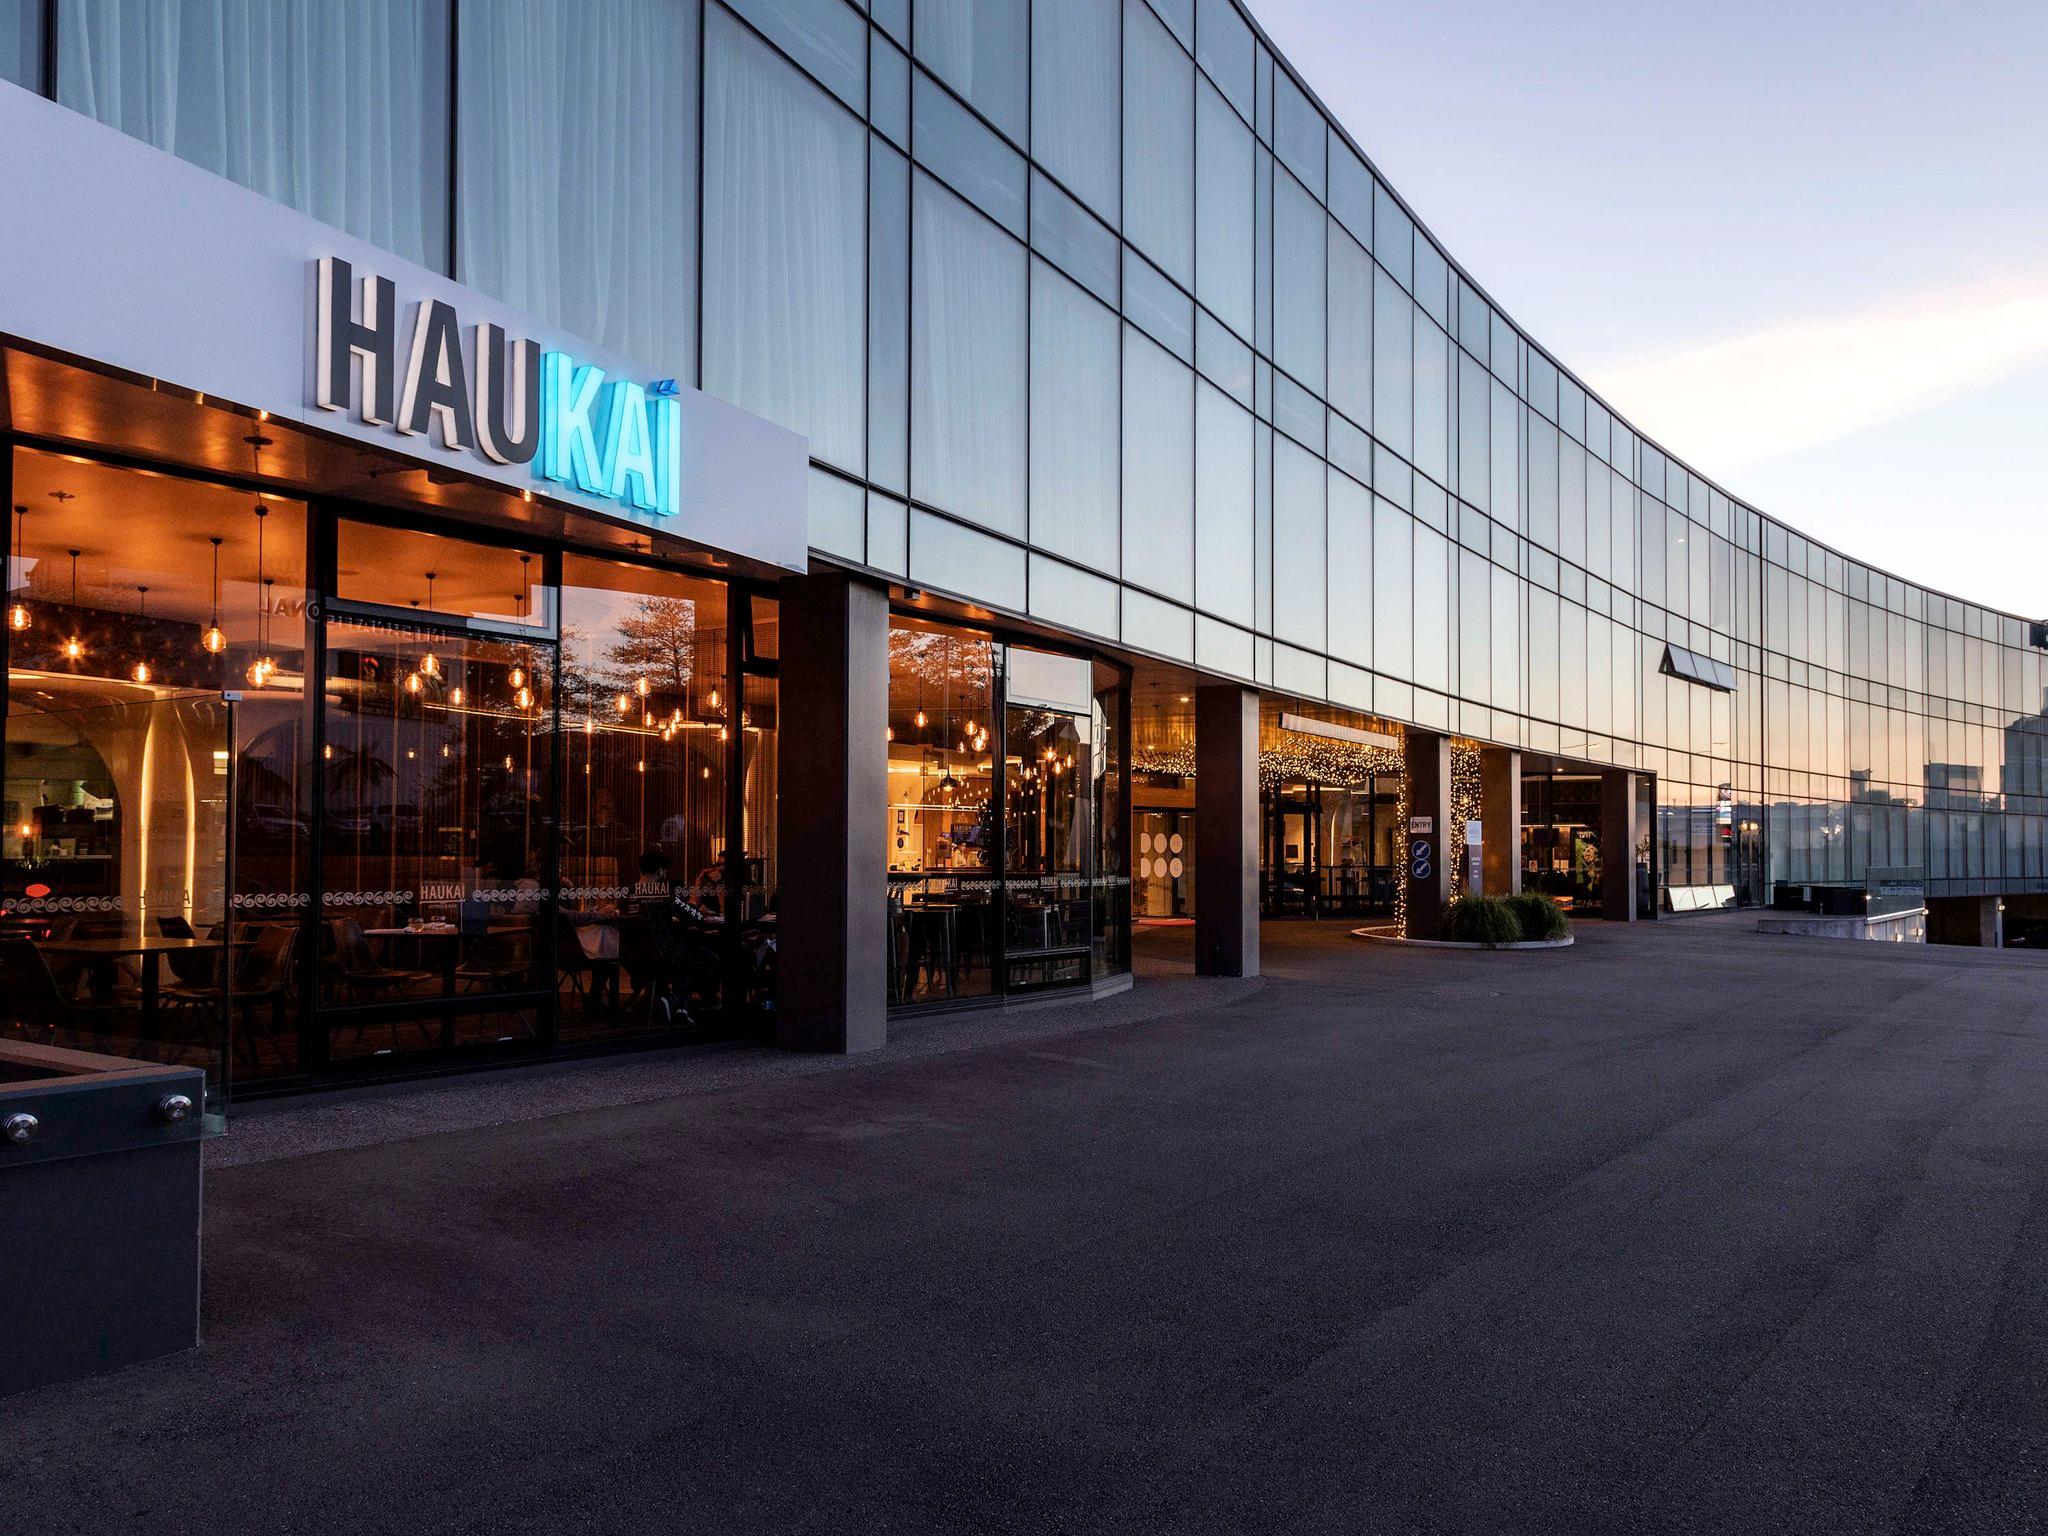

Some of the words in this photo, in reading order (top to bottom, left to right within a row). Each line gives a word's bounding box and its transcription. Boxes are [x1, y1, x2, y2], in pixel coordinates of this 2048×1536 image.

[316, 256, 682, 516] HAUKAI
[1411, 822, 1432, 831] ENTRY
[420, 884, 465, 900] HAUKAI
[635, 881, 669, 895] HAUKAI
